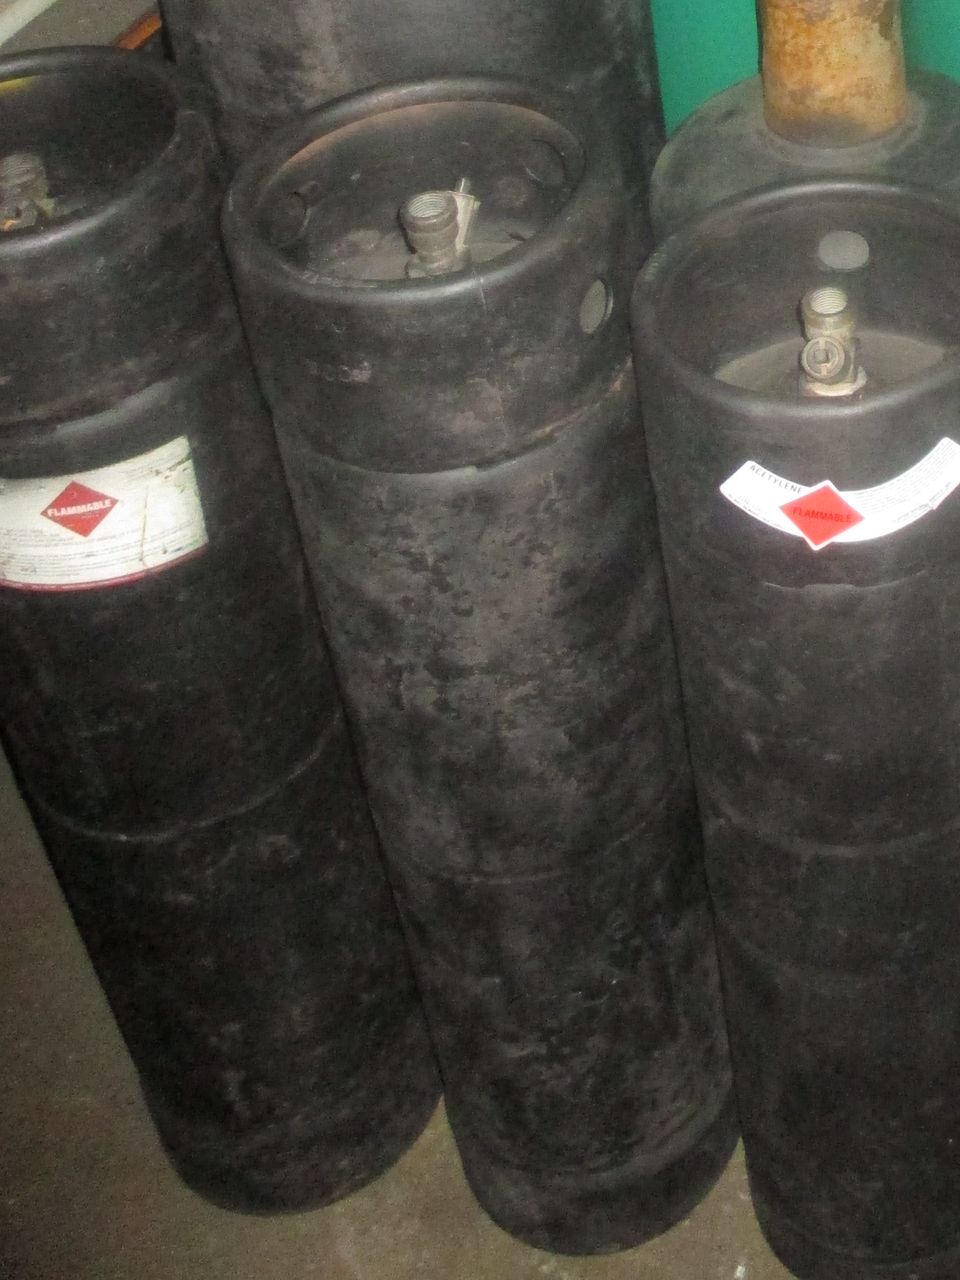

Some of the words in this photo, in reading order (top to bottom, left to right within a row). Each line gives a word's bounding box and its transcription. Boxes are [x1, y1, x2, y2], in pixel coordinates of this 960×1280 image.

[749, 464, 801, 494] ACETYLENE
[47, 498, 112, 517] FLAMMABLE
[792, 506, 852, 523] FLAMMABLE
